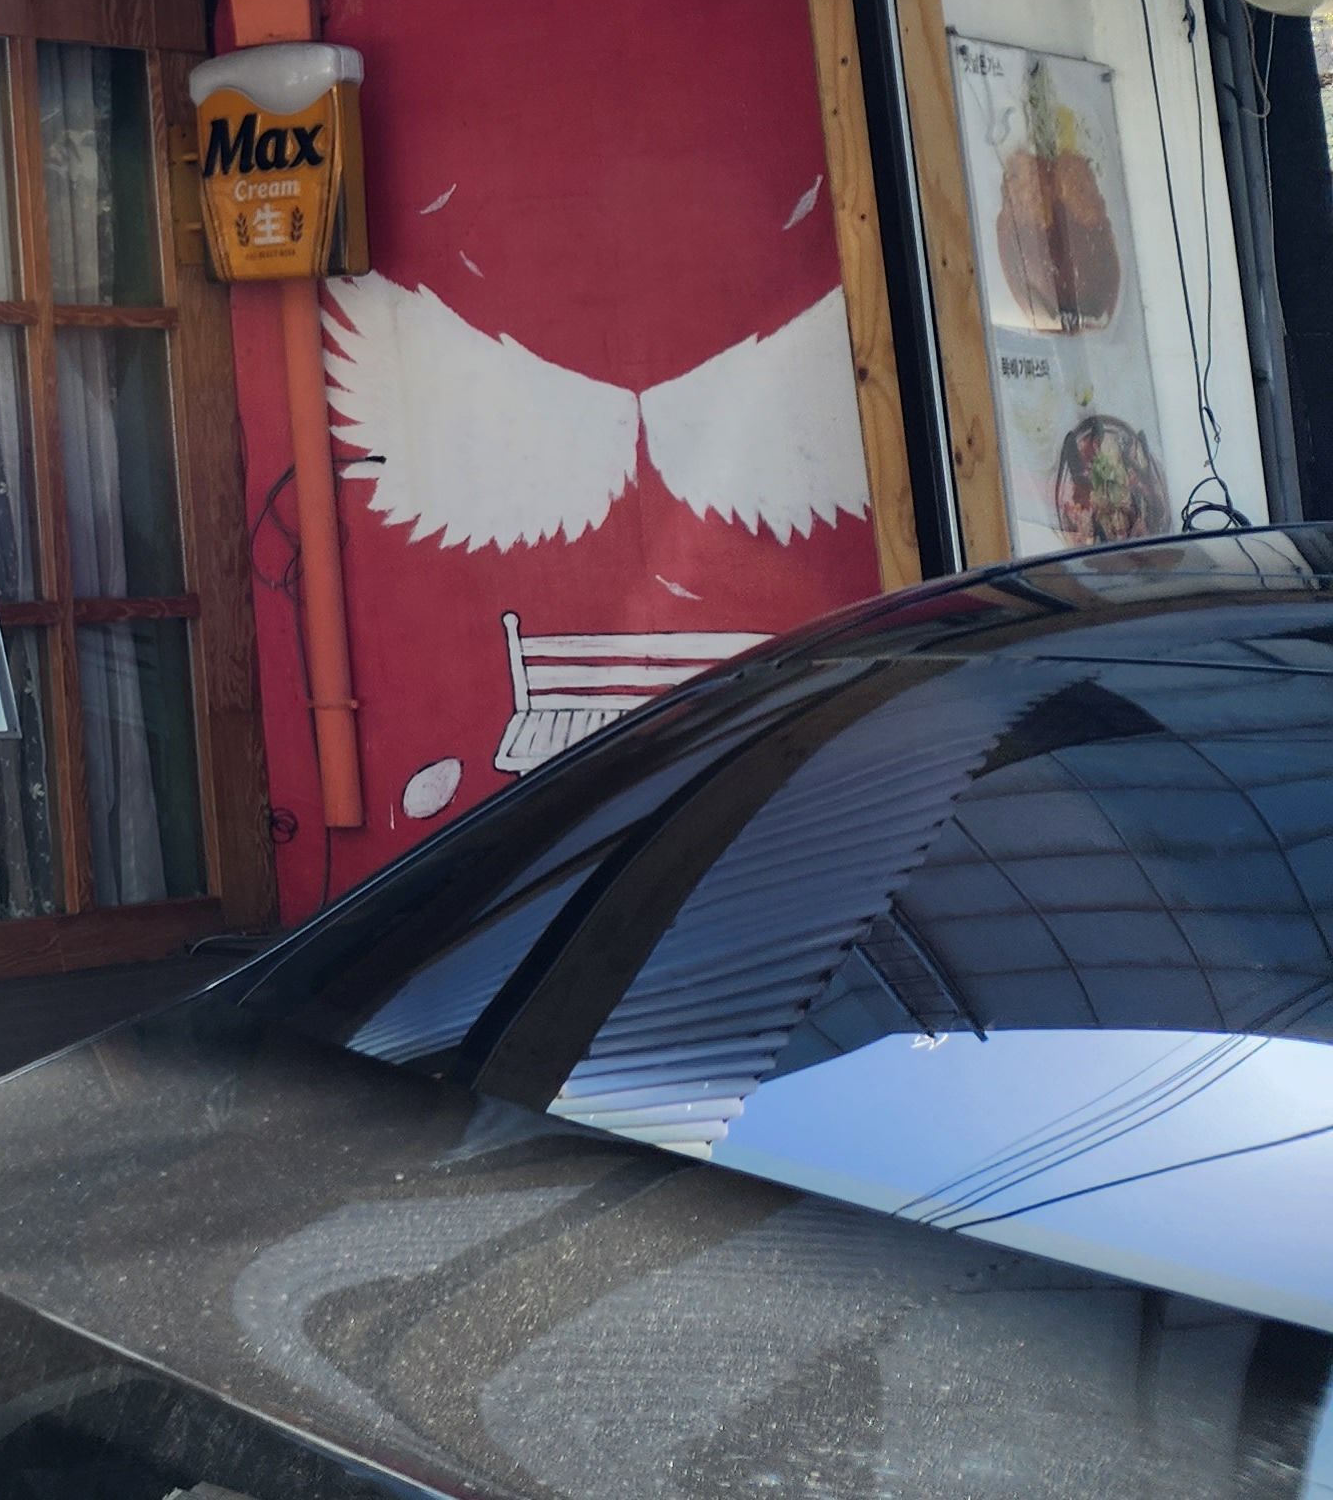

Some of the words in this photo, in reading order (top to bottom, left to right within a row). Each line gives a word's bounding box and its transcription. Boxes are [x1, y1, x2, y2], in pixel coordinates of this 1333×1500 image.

[203, 113, 326, 178] Max
[234, 179, 301, 202] Cream
[253, 203, 286, 245] 生
